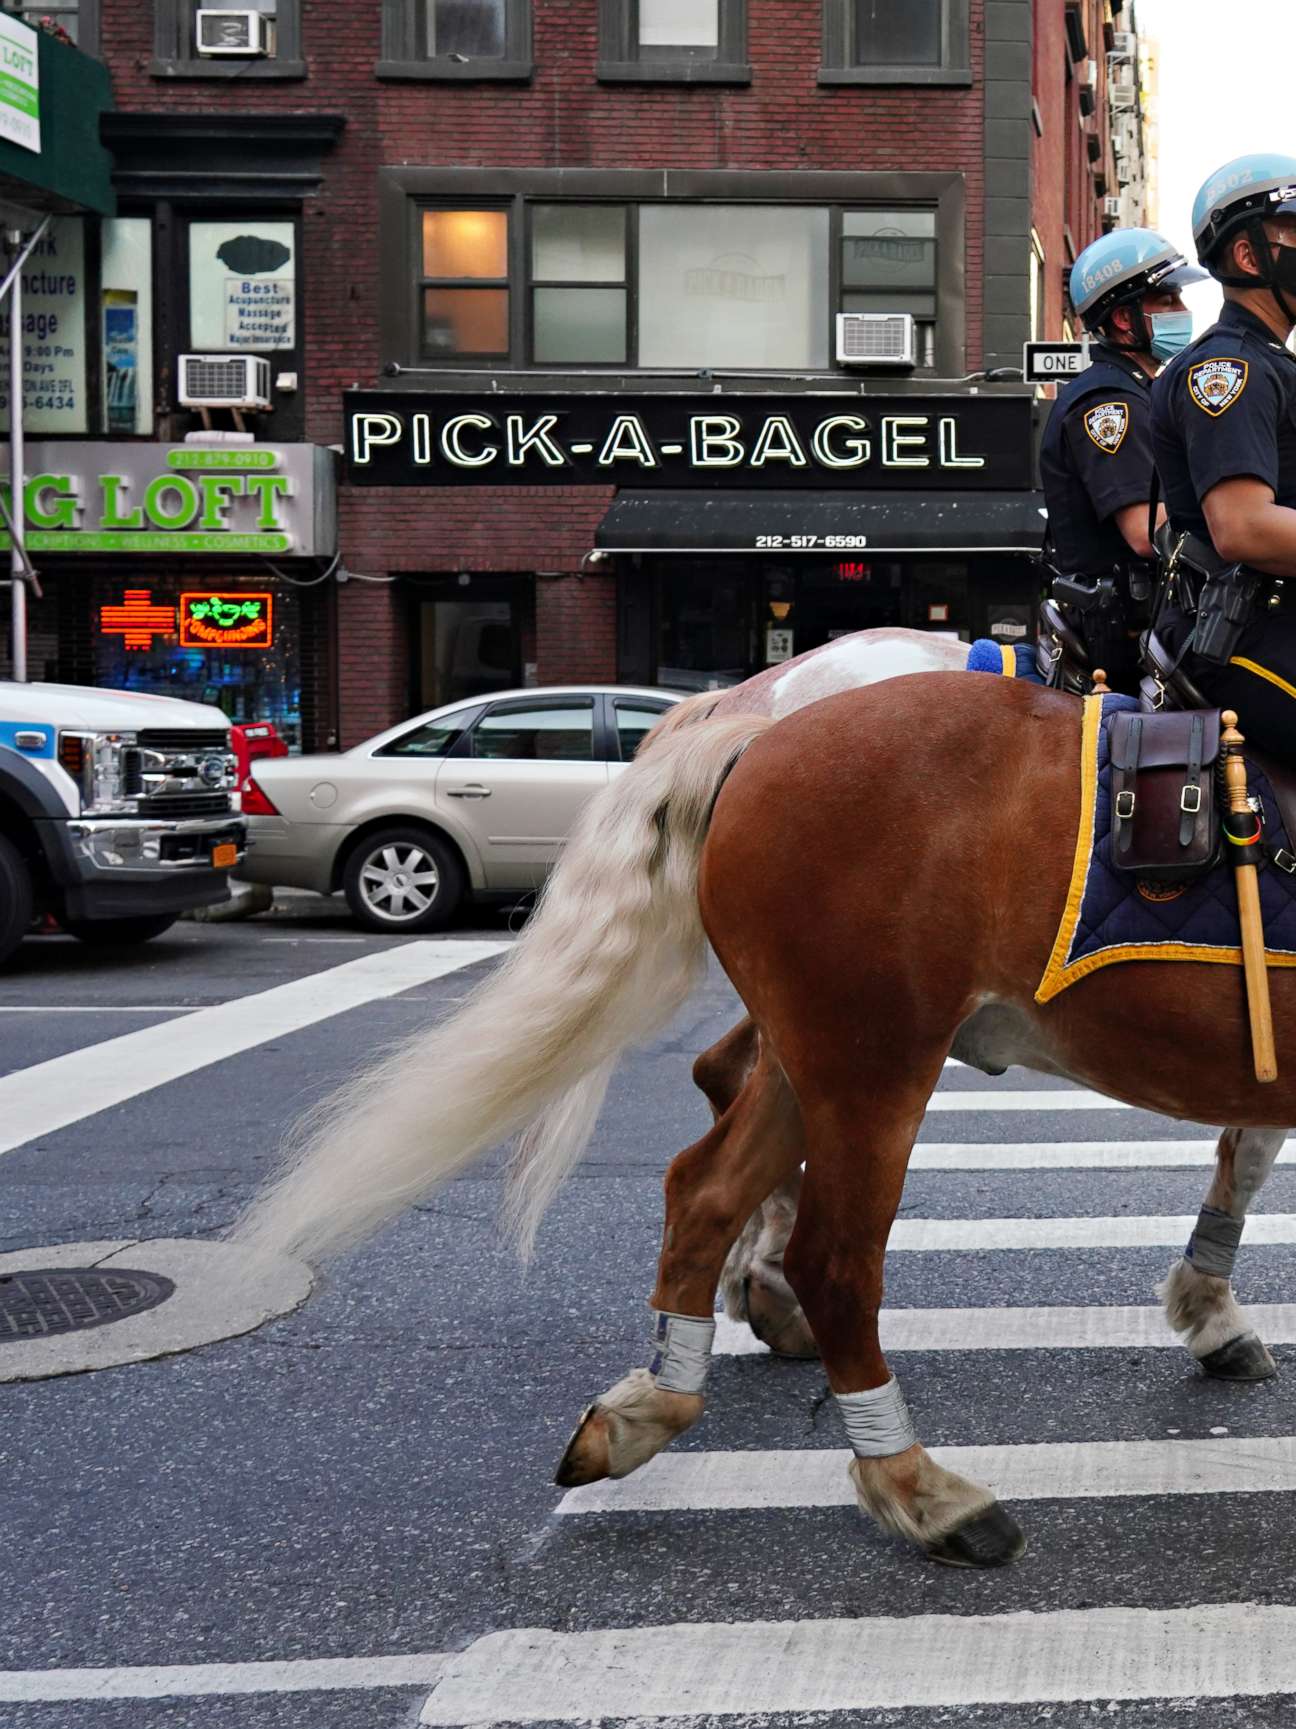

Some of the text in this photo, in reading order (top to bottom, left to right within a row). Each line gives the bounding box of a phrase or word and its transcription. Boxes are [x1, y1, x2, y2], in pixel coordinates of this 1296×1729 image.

[241, 282, 278, 294] Best
[229, 295, 291, 305] Acupuncture
[239, 308, 282, 320] Massage
[239, 320, 288, 333] Accepted
[23, 361, 54, 375] Days
[1043, 355, 1077, 370] ONE
[1203, 361, 1232, 370] POLICE
[1193, 367, 1242, 379] DEPARTMENT
[351, 412, 986, 467] PICK-A-BAGEL
[99, 473, 290, 529] LOFT
[205, 534, 281, 548] COSMETICS
[755, 535, 867, 548] 212-517-6590
